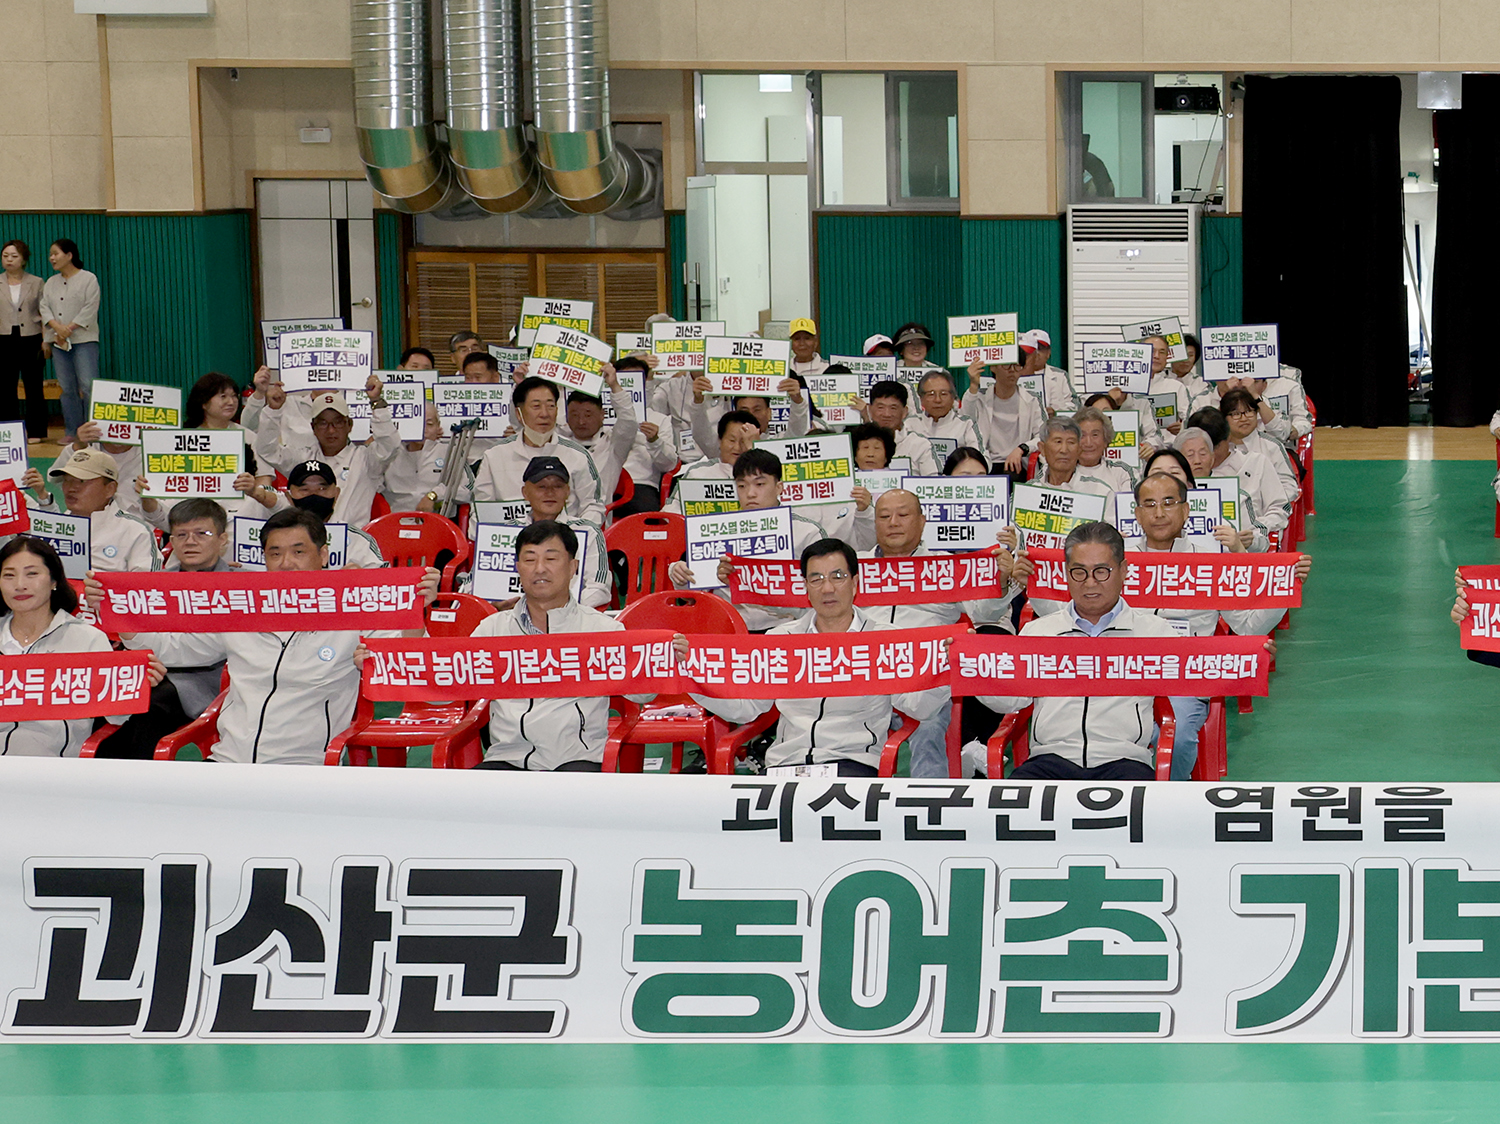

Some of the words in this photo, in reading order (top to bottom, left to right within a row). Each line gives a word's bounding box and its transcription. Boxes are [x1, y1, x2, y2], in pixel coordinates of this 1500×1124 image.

[970, 319, 996, 332] 괴산군
[556, 331, 589, 351] 괴산군
[732, 342, 763, 356] 괴산군
[952, 334, 978, 349] 농어촌
[981, 332, 1014, 346] 기본소득
[282, 353, 311, 368] 농어촌
[314, 352, 334, 366] 기본
[337, 352, 368, 366] 소득이
[532, 344, 561, 363] 농어촌
[1204, 346, 1229, 360] 농어촌
[1232, 346, 1248, 359] 기본
[1251, 344, 1275, 358] 소득이
[537, 362, 558, 378] 선정
[561, 368, 586, 385] 기원!
[709, 358, 740, 374] 농어촌
[744, 360, 785, 375] 기본소득
[1228, 361, 1254, 373] 만든다!
[307, 370, 341, 382] 만든다!
[722, 377, 742, 390] 선정
[747, 378, 769, 391] 기원!
[119, 387, 154, 404] 괴산군
[94, 404, 128, 420] 농어촌
[131, 407, 178, 426] 기본소득
[108, 424, 131, 439] 선정
[174, 435, 211, 451] 괴산군
[785, 442, 821, 460] 괴산군
[149, 456, 186, 472] 농어촌
[189, 456, 238, 473] 기본소득
[804, 459, 850, 480] 기본소득
[165, 476, 189, 492] 선정
[193, 477, 221, 492] 기원!
[806, 481, 834, 498] 기원!
[944, 505, 967, 522] 기본
[969, 503, 1004, 522] 소득이
[937, 524, 974, 542] 만든다!
[691, 541, 728, 560] 농어촌
[731, 538, 751, 553] 기본
[754, 534, 788, 554] 소득이
[737, 563, 788, 593] 괴산군
[920, 557, 955, 590] 선정
[960, 551, 998, 586] 기원!
[1146, 565, 1213, 596] 기본소득
[1218, 563, 1251, 596] 선정
[1256, 561, 1295, 596] 기원!
[108, 587, 166, 616] 농어촌
[168, 587, 255, 615] 기본소득!
[260, 589, 336, 614] 괴산군을
[341, 585, 417, 614] 선정한다
[370, 655, 426, 687] 괴산군
[431, 652, 495, 685] 농어촌
[499, 649, 581, 684] 기본소득
[585, 645, 626, 682] 선정
[633, 640, 676, 682] 기원!
[730, 649, 789, 684] 농어촌
[794, 645, 871, 683] 기본소득
[877, 641, 913, 678] 선정
[959, 650, 1016, 679] 농어촌
[1019, 653, 1100, 680] 기본소득!
[1105, 652, 1179, 679] 괴산군을
[1184, 652, 1257, 679] 선정한다
[50, 668, 91, 705] 선정
[97, 664, 144, 701] 기원!
[721, 783, 1144, 843] 괴산군민의
[1204, 785, 1453, 843] 염원을
[12, 862, 574, 1036] 괴산군
[629, 857, 1172, 1035] 농어촌
